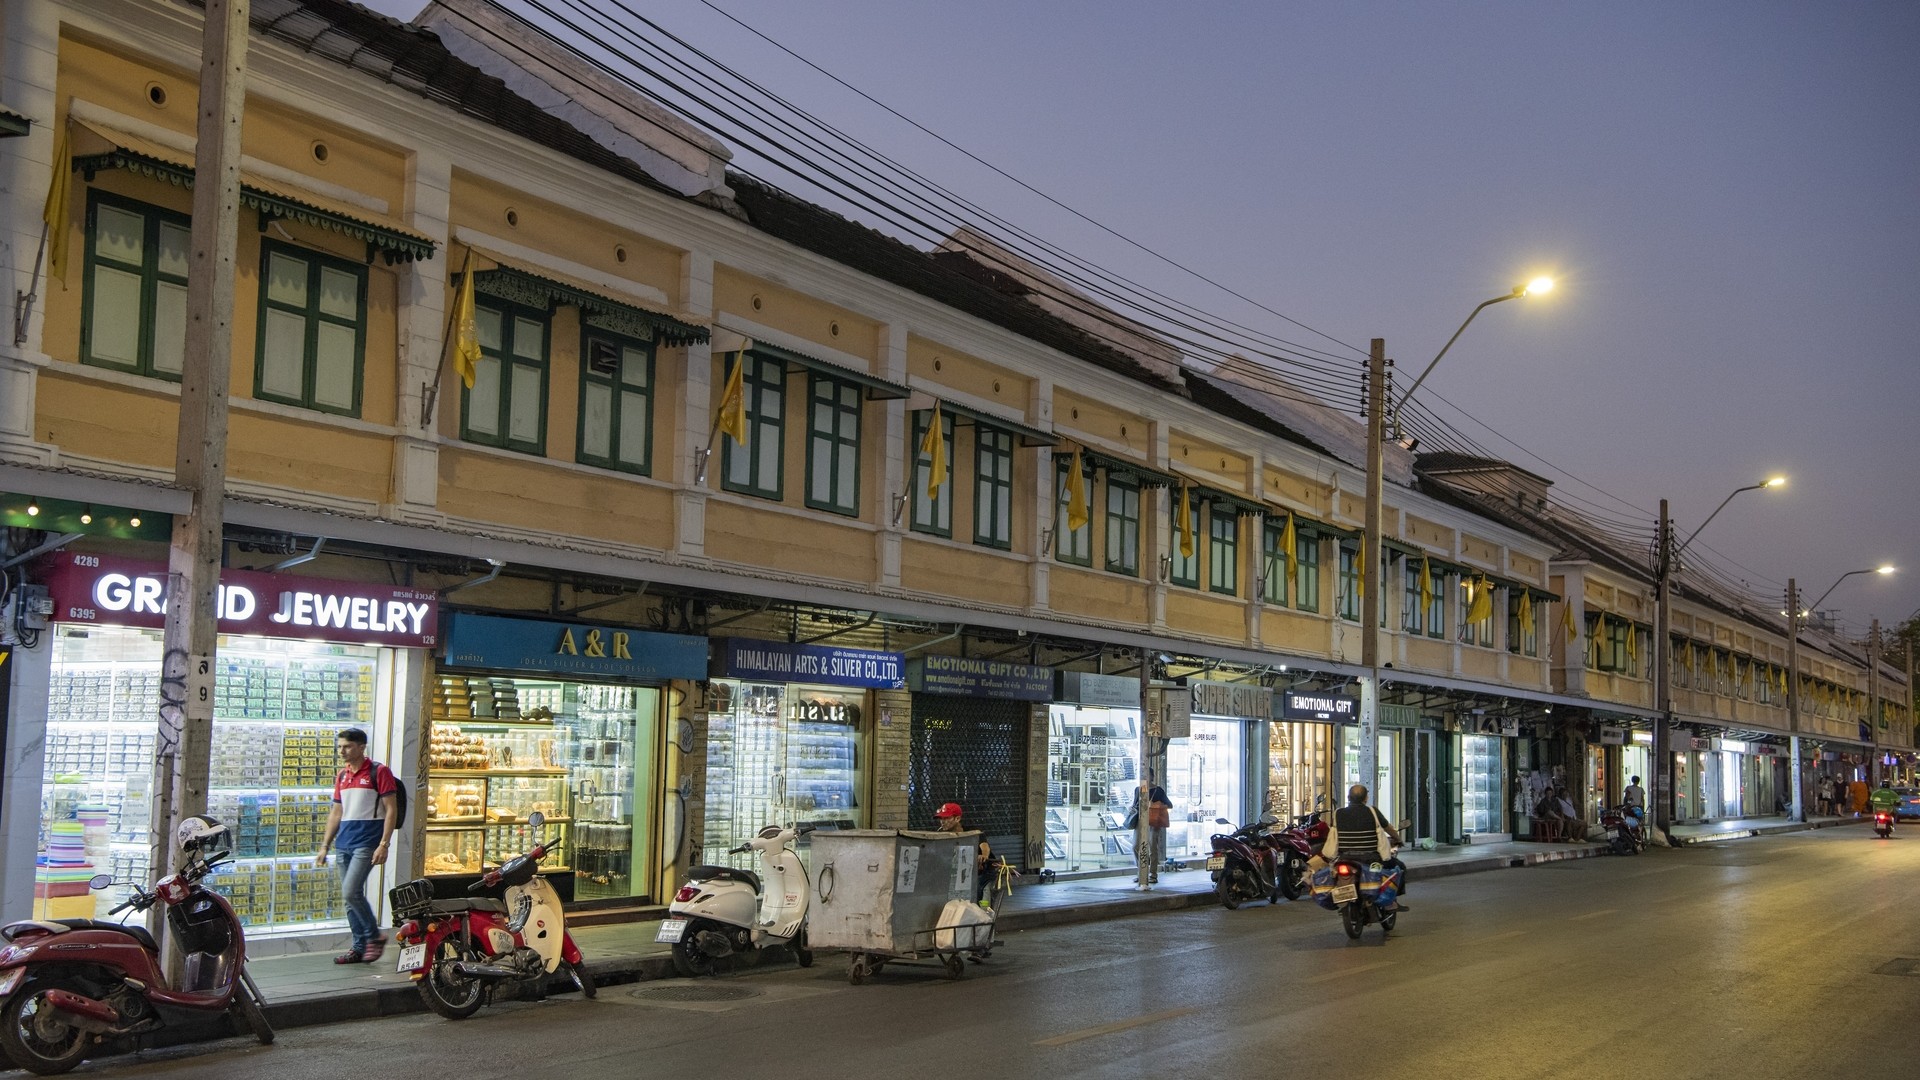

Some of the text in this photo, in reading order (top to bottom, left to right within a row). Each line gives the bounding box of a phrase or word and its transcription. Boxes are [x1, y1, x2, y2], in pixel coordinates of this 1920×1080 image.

[74, 555, 99, 568] 4289
[94, 573, 429, 634] GRD JEWELRY
[70, 608, 96, 620] 6395
[422, 636, 434, 645] 126
[558, 627, 632, 660] A & R
[520, 658, 548, 666] IDEAL
[554, 660, 585, 668] SILVER
[736, 649, 900, 682] HIMALAYAN ARTS & SILVER CO.,LTD.
[927, 656, 1052, 680] EMOTIONAL GIFT CO.,LTD.
[1026, 682, 1048, 692] FACTORY
[1192, 683, 1272, 720] SUPER SILVER
[1292, 696, 1352, 713] EMOTIONAL GIFT
[1396, 708, 1415, 724] LAND
[1078, 735, 1106, 745] BIZPIERCE
